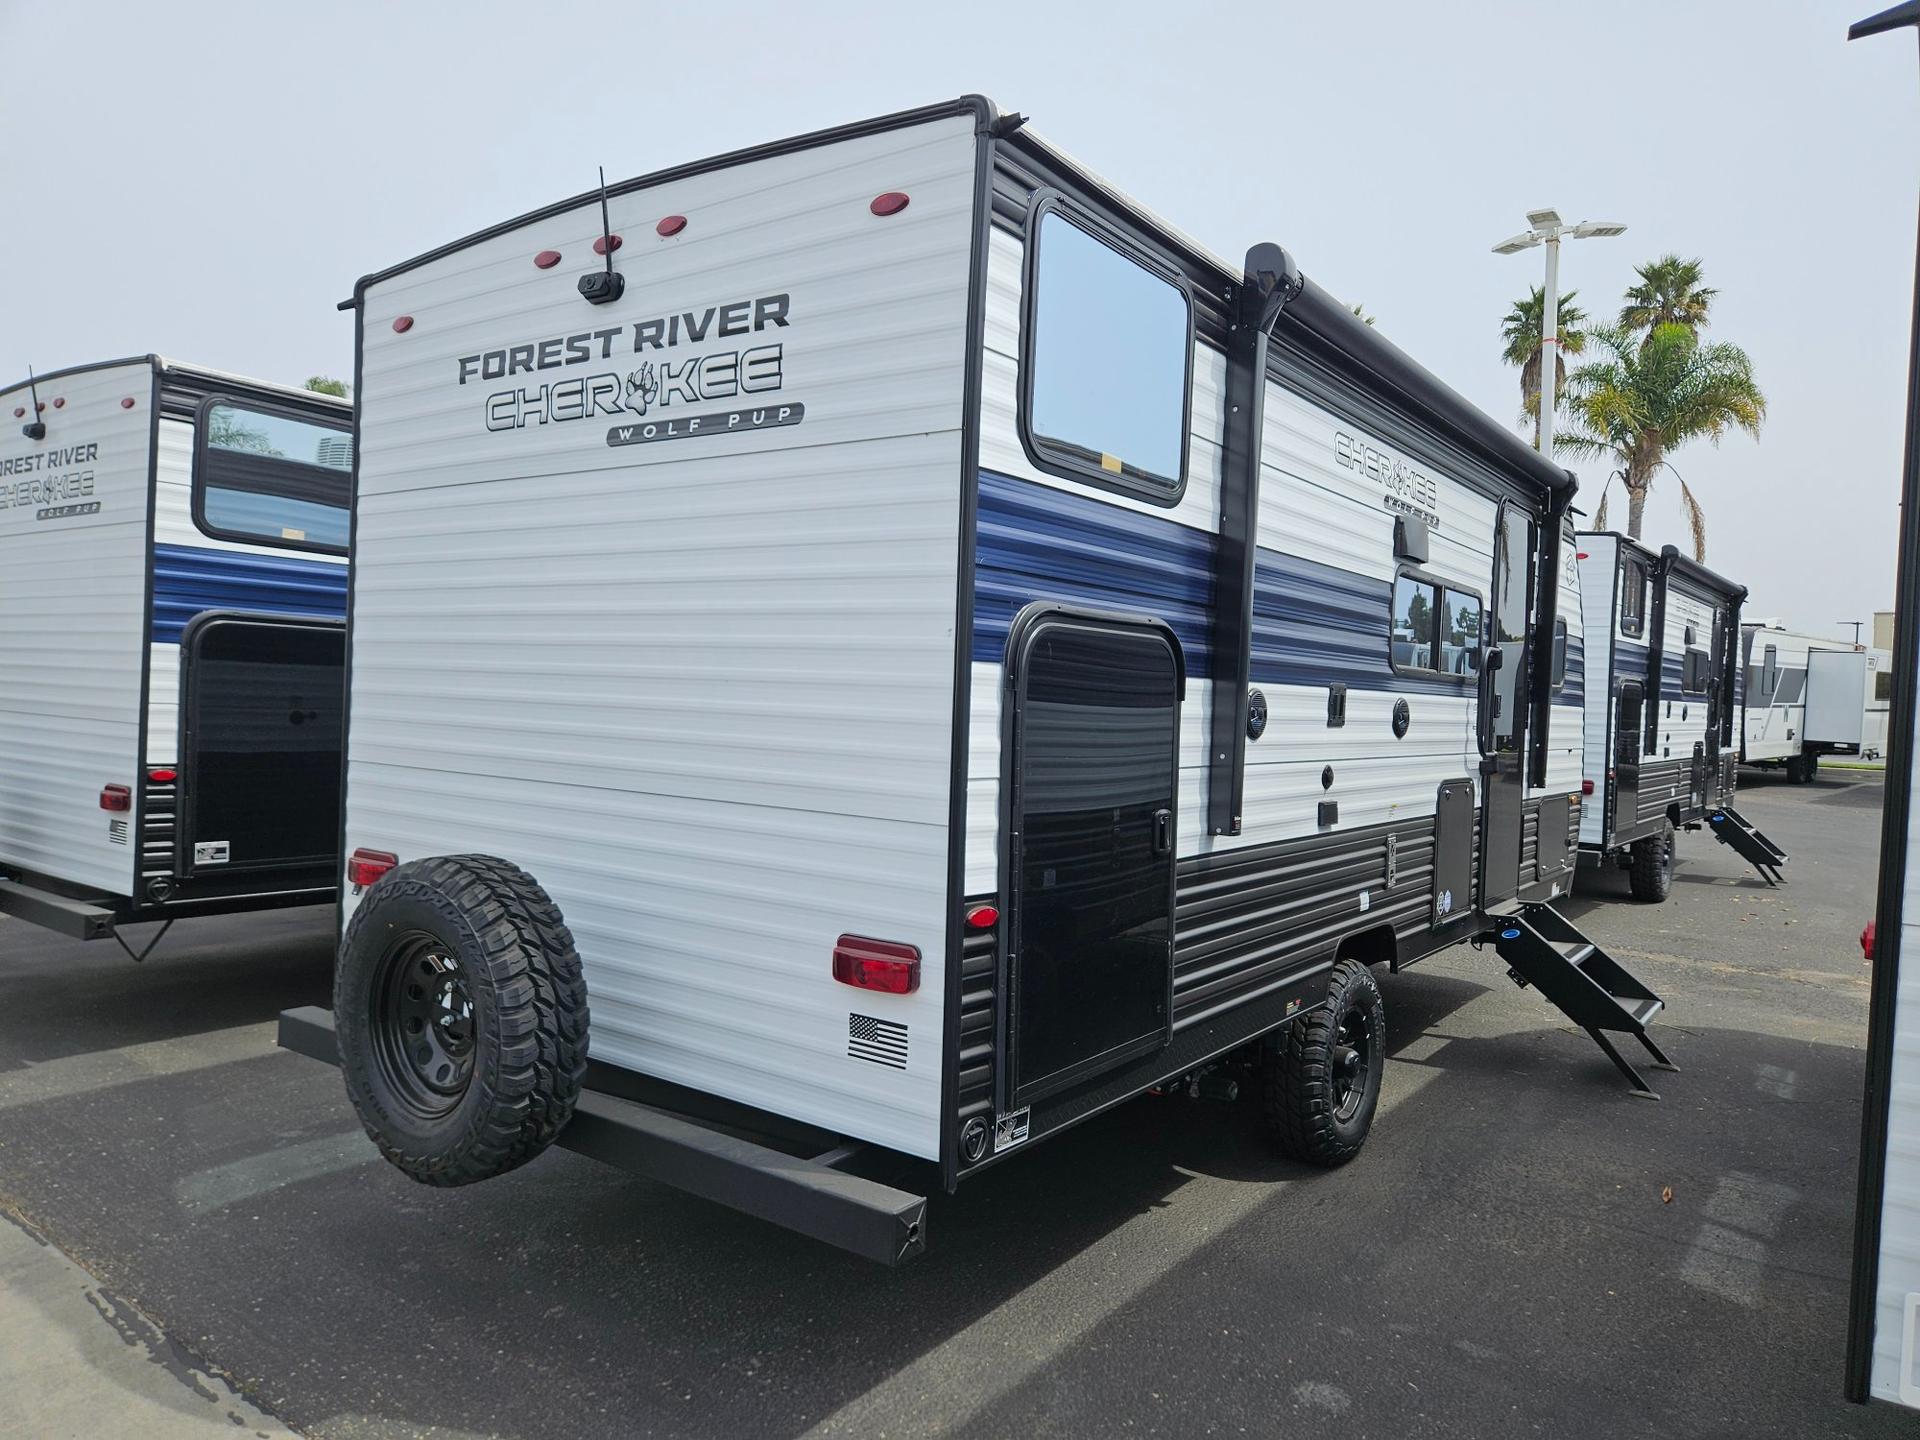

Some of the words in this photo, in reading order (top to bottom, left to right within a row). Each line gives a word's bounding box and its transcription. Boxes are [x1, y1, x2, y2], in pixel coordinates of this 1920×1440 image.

[458, 326, 623, 385] FOREST
[633, 293, 791, 354] RIVER
[618, 418, 701, 442] WOLF
[728, 407, 791, 429] PUP
[0, 453, 45, 477] REST
[48, 443, 98, 468] RIVER
[1388, 497, 1415, 515] WOLF
[1421, 511, 1437, 525] PUP
